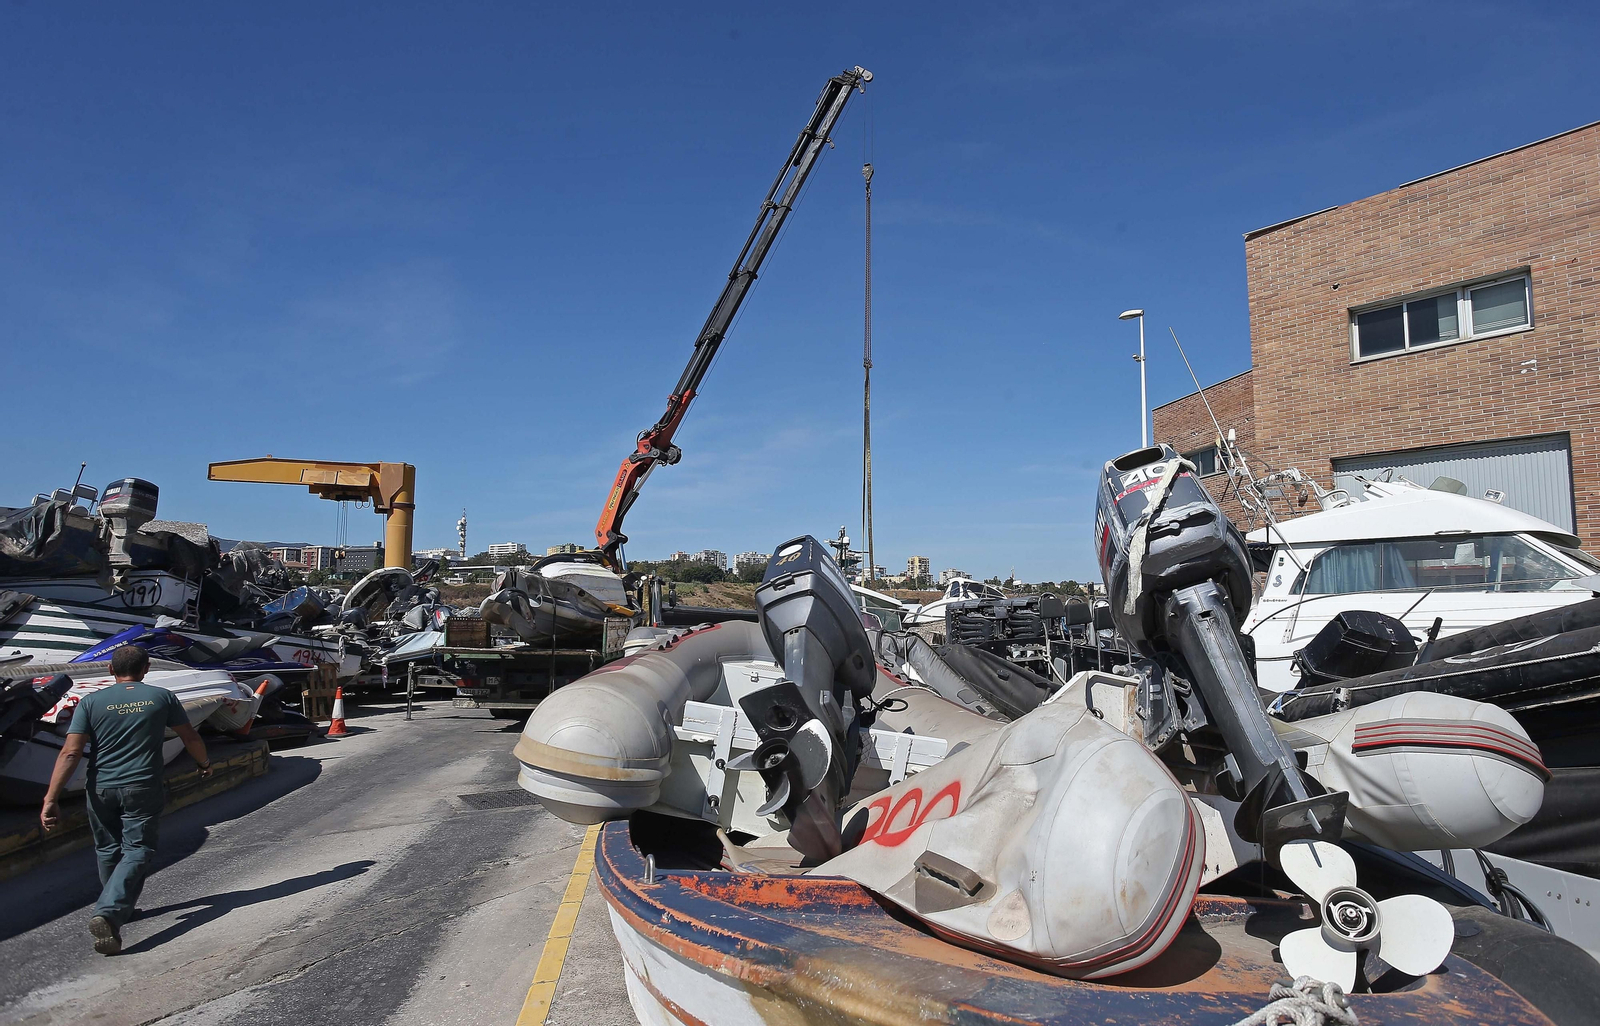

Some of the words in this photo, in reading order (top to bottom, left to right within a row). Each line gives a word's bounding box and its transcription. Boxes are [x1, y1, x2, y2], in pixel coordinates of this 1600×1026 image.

[126, 584, 157, 605] 191
[106, 700, 155, 711] GUARDIA
[118, 706, 145, 715] CIVIL
